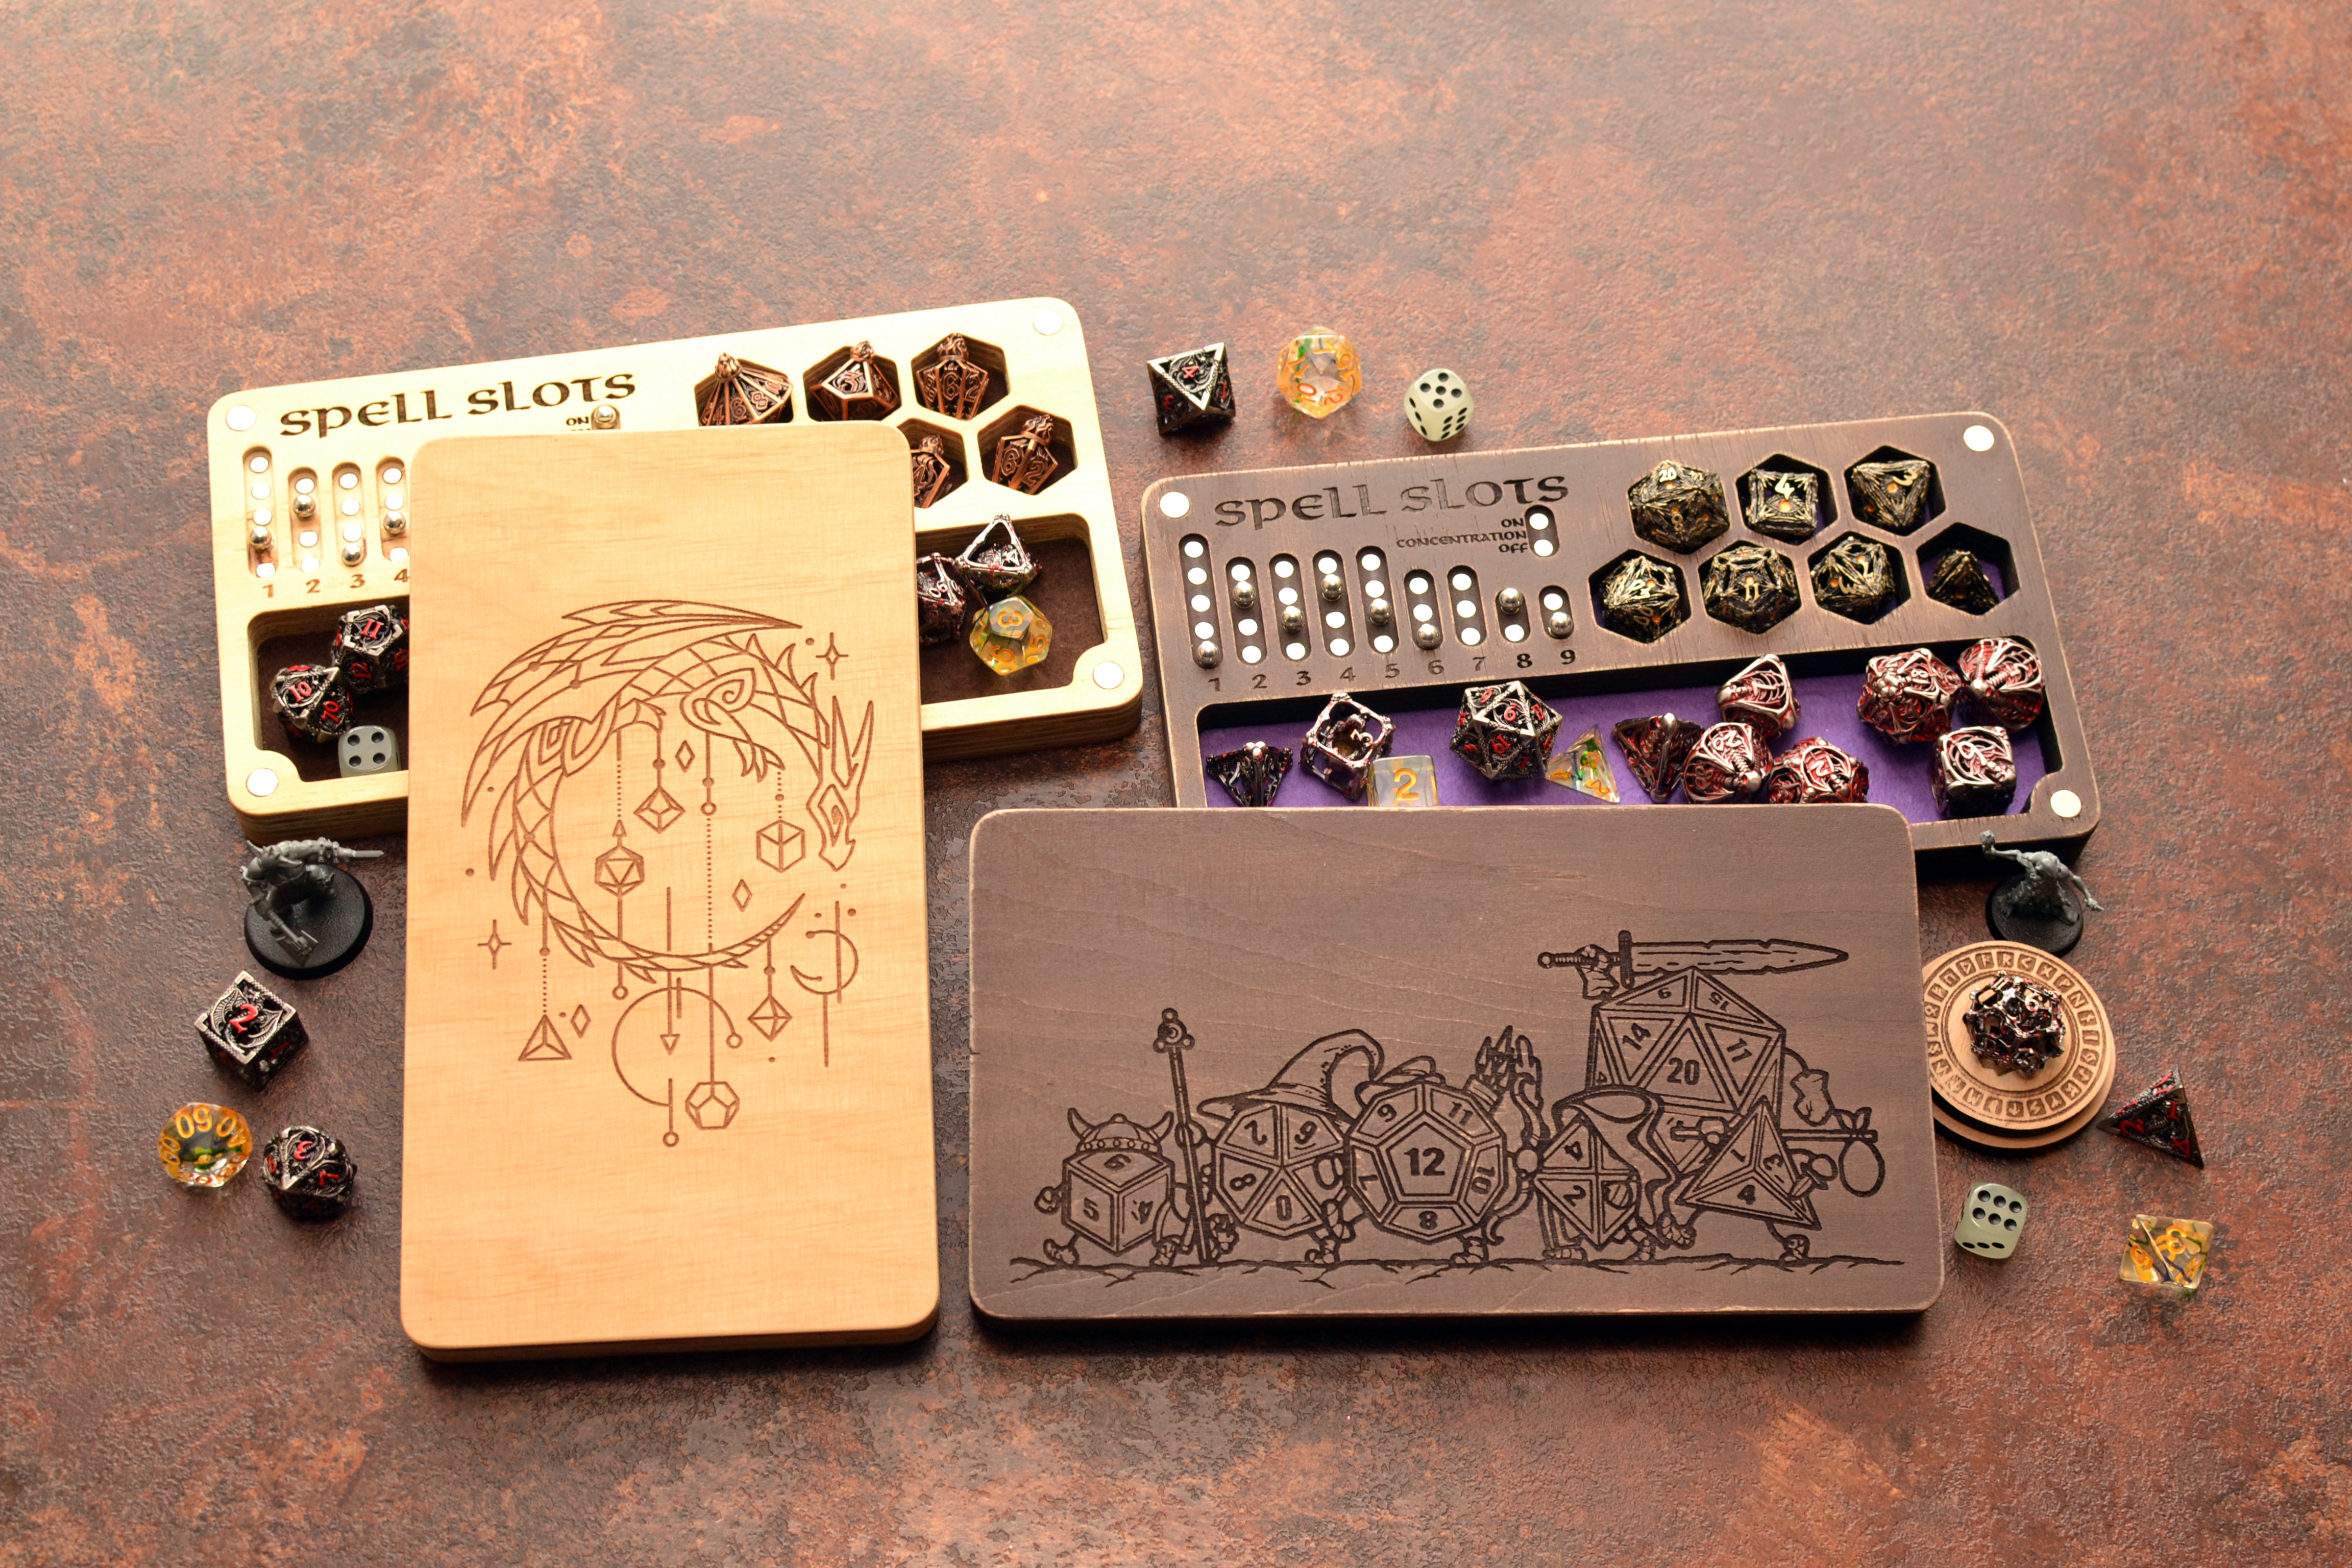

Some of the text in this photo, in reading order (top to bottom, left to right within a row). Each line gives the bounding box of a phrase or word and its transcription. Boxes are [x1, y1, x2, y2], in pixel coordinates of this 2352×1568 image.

[943, 372, 959, 401] 6
[566, 416, 589, 426] ON
[1659, 467, 1677, 482] 20
[1775, 474, 1795, 500] 4
[1501, 518, 1524, 527] ON
[1396, 530, 1527, 548] CONCENTRATION
[1499, 543, 1528, 553] OFF
[262, 584, 274, 598] 1
[306, 579, 321, 594] 2
[350, 574, 365, 589] 3
[1208, 650, 1576, 693] 1 2 3 4 5 6 7 8 9
[1394, 768, 1419, 800] 2
[228, 1003, 258, 1034] 2
[1622, 1022, 1652, 1051] 14
[1667, 1057, 1700, 1085] 20
[1448, 1101, 1474, 1126] 11
[1404, 1147, 1446, 1176] 12
[1230, 1173, 1257, 1191] 8
[1471, 1166, 1496, 1194] 10
[1276, 1195, 1292, 1221] 0
[1419, 1211, 1438, 1230] 8
